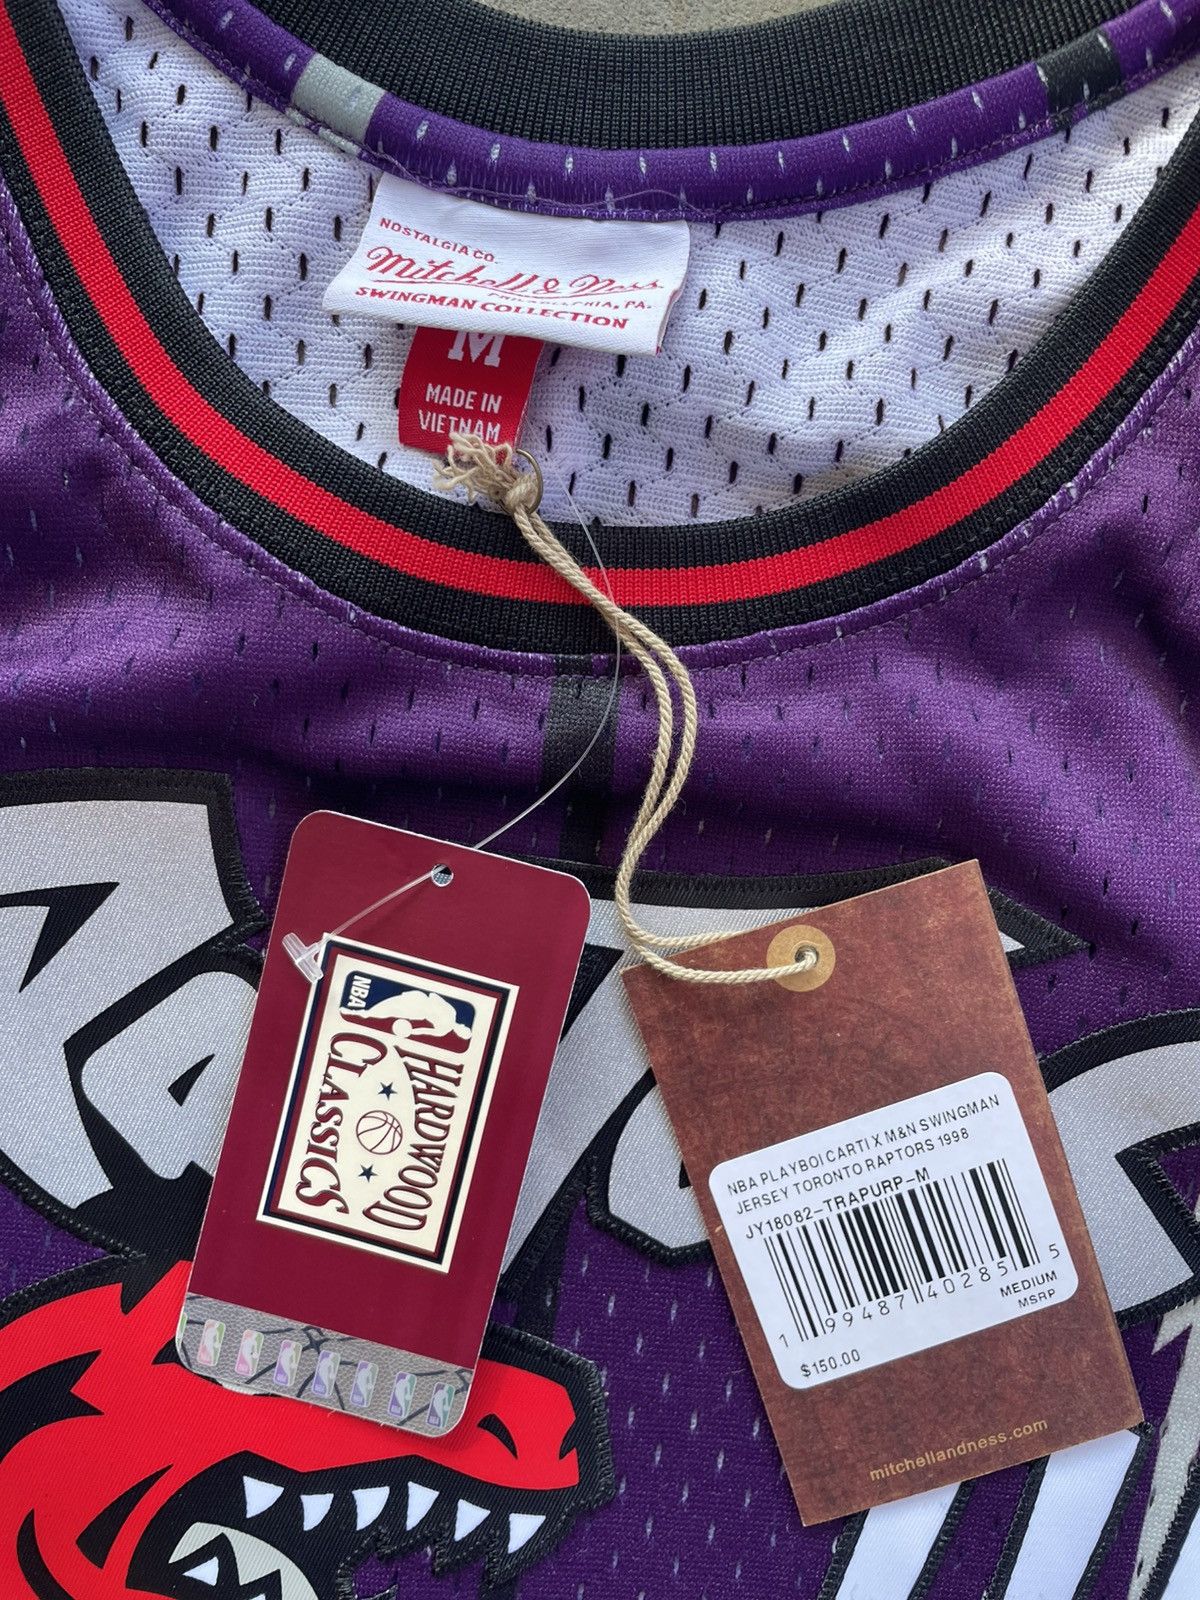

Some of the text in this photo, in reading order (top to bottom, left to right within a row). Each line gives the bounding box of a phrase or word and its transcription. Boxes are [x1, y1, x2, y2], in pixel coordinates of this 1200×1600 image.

[379, 217, 500, 265] NOSTALGIA CO.
[366, 246, 538, 291] Mitchell
[355, 286, 630, 329] SWINGMAN COLLECTION
[447, 330, 506, 368] M
[425, 383, 502, 414] MADE IN
[418, 409, 501, 443] VIETNAM
[347, 974, 372, 1008] NBA
[295, 1032, 388, 1215] CLASSICS
[363, 1044, 464, 1231] HARDWOOD
[727, 1094, 1000, 1196] NBA PLAYBOI CARTI X M&N SWINGMAN
[736, 1127, 970, 1215] JERSEY TORONTO RAPTORS 1998
[1000, 1270, 1058, 1298] MEDIUM
[1018, 1288, 1057, 1309] MSRP
[800, 1348, 861, 1378] $150.00
[869, 1418, 1049, 1482] mitchellandness.com
